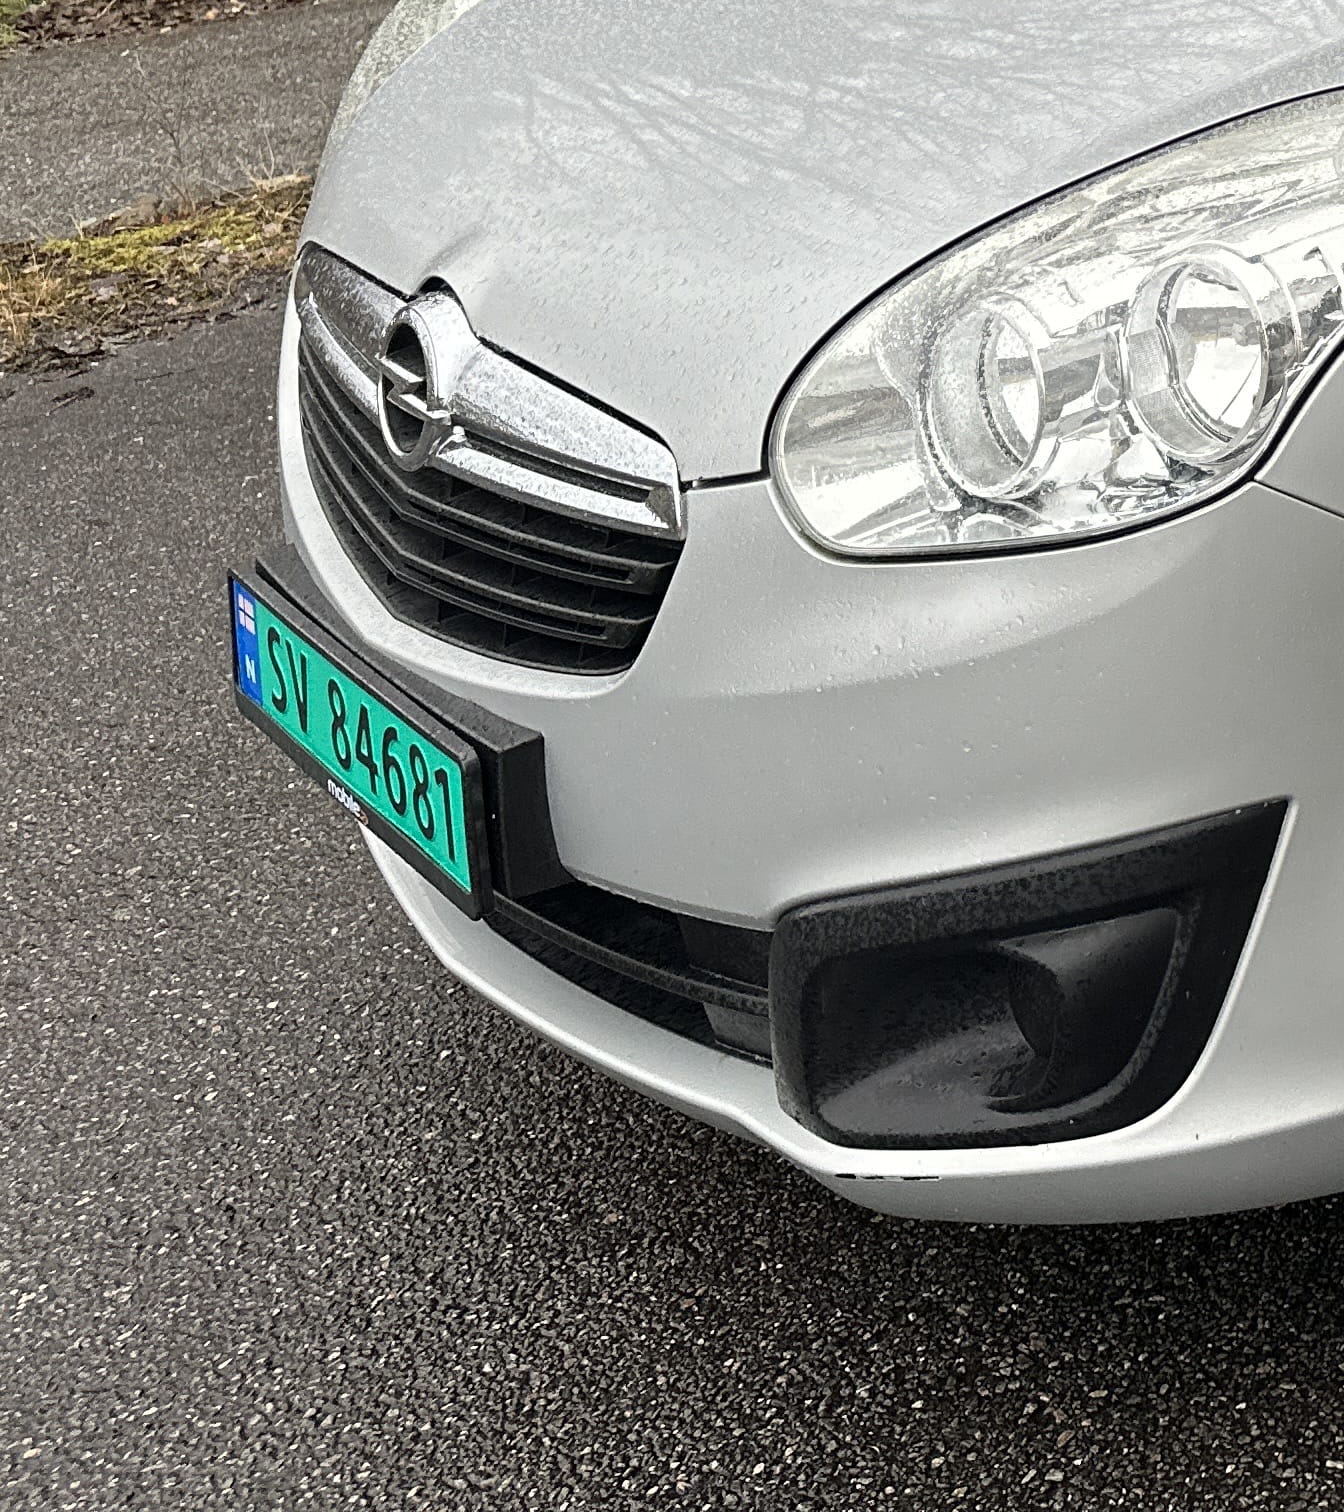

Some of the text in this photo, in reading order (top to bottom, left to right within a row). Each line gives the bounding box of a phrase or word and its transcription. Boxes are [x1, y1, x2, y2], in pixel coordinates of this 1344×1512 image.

[244, 653, 257, 684] N
[267, 626, 456, 865] SV 84681
